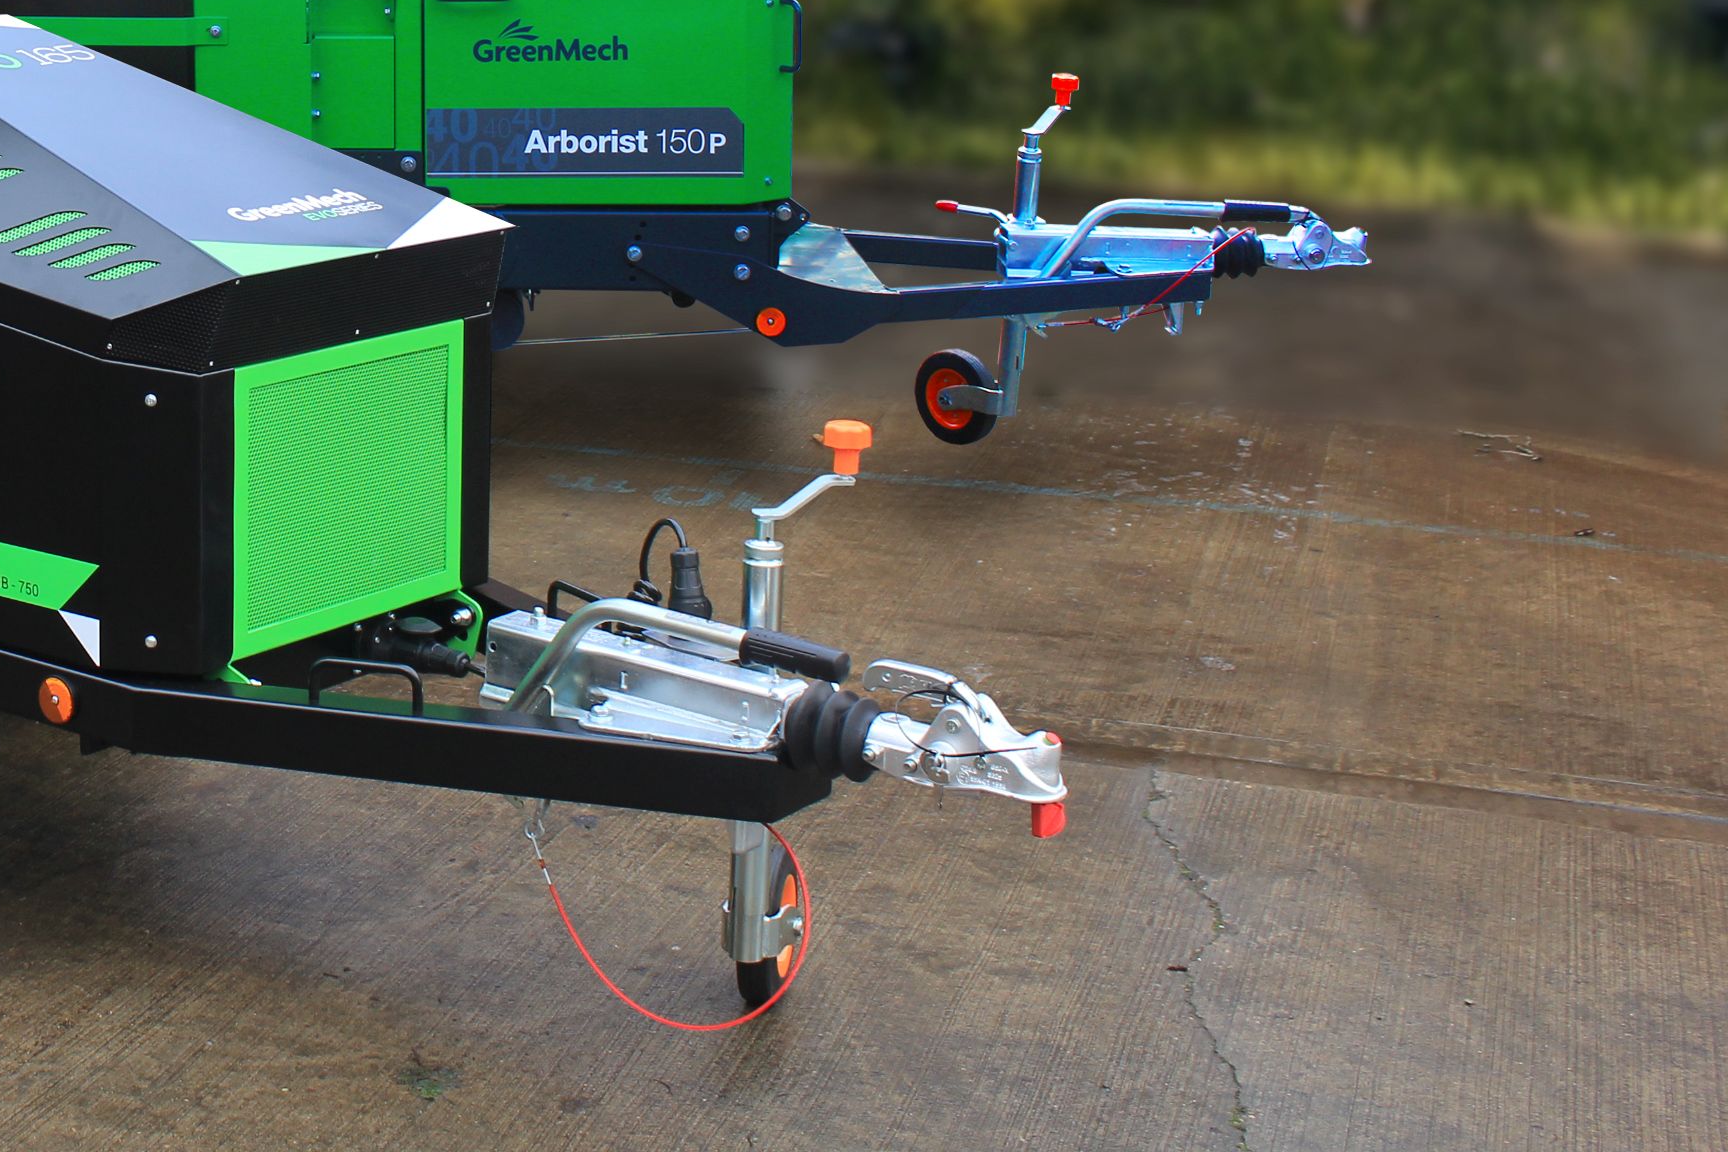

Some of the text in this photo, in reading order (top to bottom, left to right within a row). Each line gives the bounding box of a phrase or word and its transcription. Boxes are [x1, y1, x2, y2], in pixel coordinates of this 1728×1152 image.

[16, 44, 97, 66] 165
[473, 35, 629, 63] GreenMech
[524, 128, 649, 154] Arborist
[227, 188, 368, 222] GreenMech
[18, 579, 40, 598] 750
